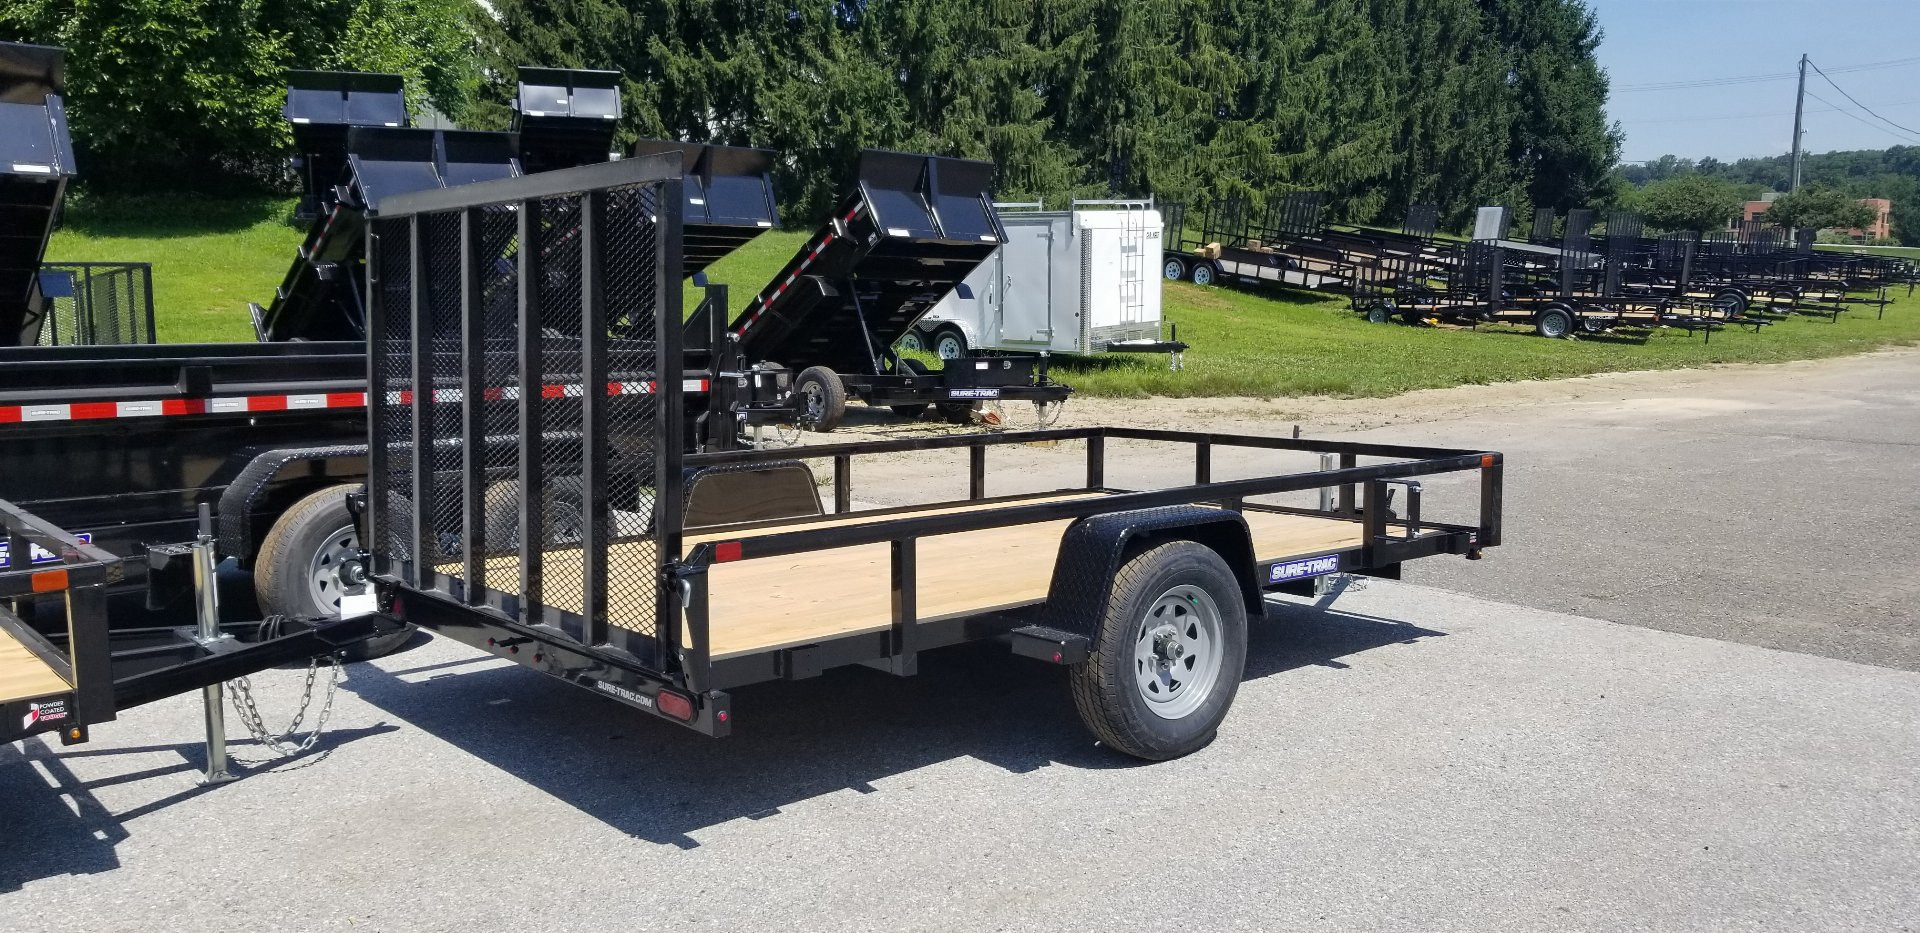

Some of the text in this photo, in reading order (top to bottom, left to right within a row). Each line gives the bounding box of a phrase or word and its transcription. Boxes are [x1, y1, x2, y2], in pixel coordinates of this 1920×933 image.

[1272, 557, 1336, 580] SURE-TRAC
[597, 680, 652, 708] SURE-TRAC.COM
[40, 701, 64, 709] POWDER
[40, 707, 64, 715] COATED
